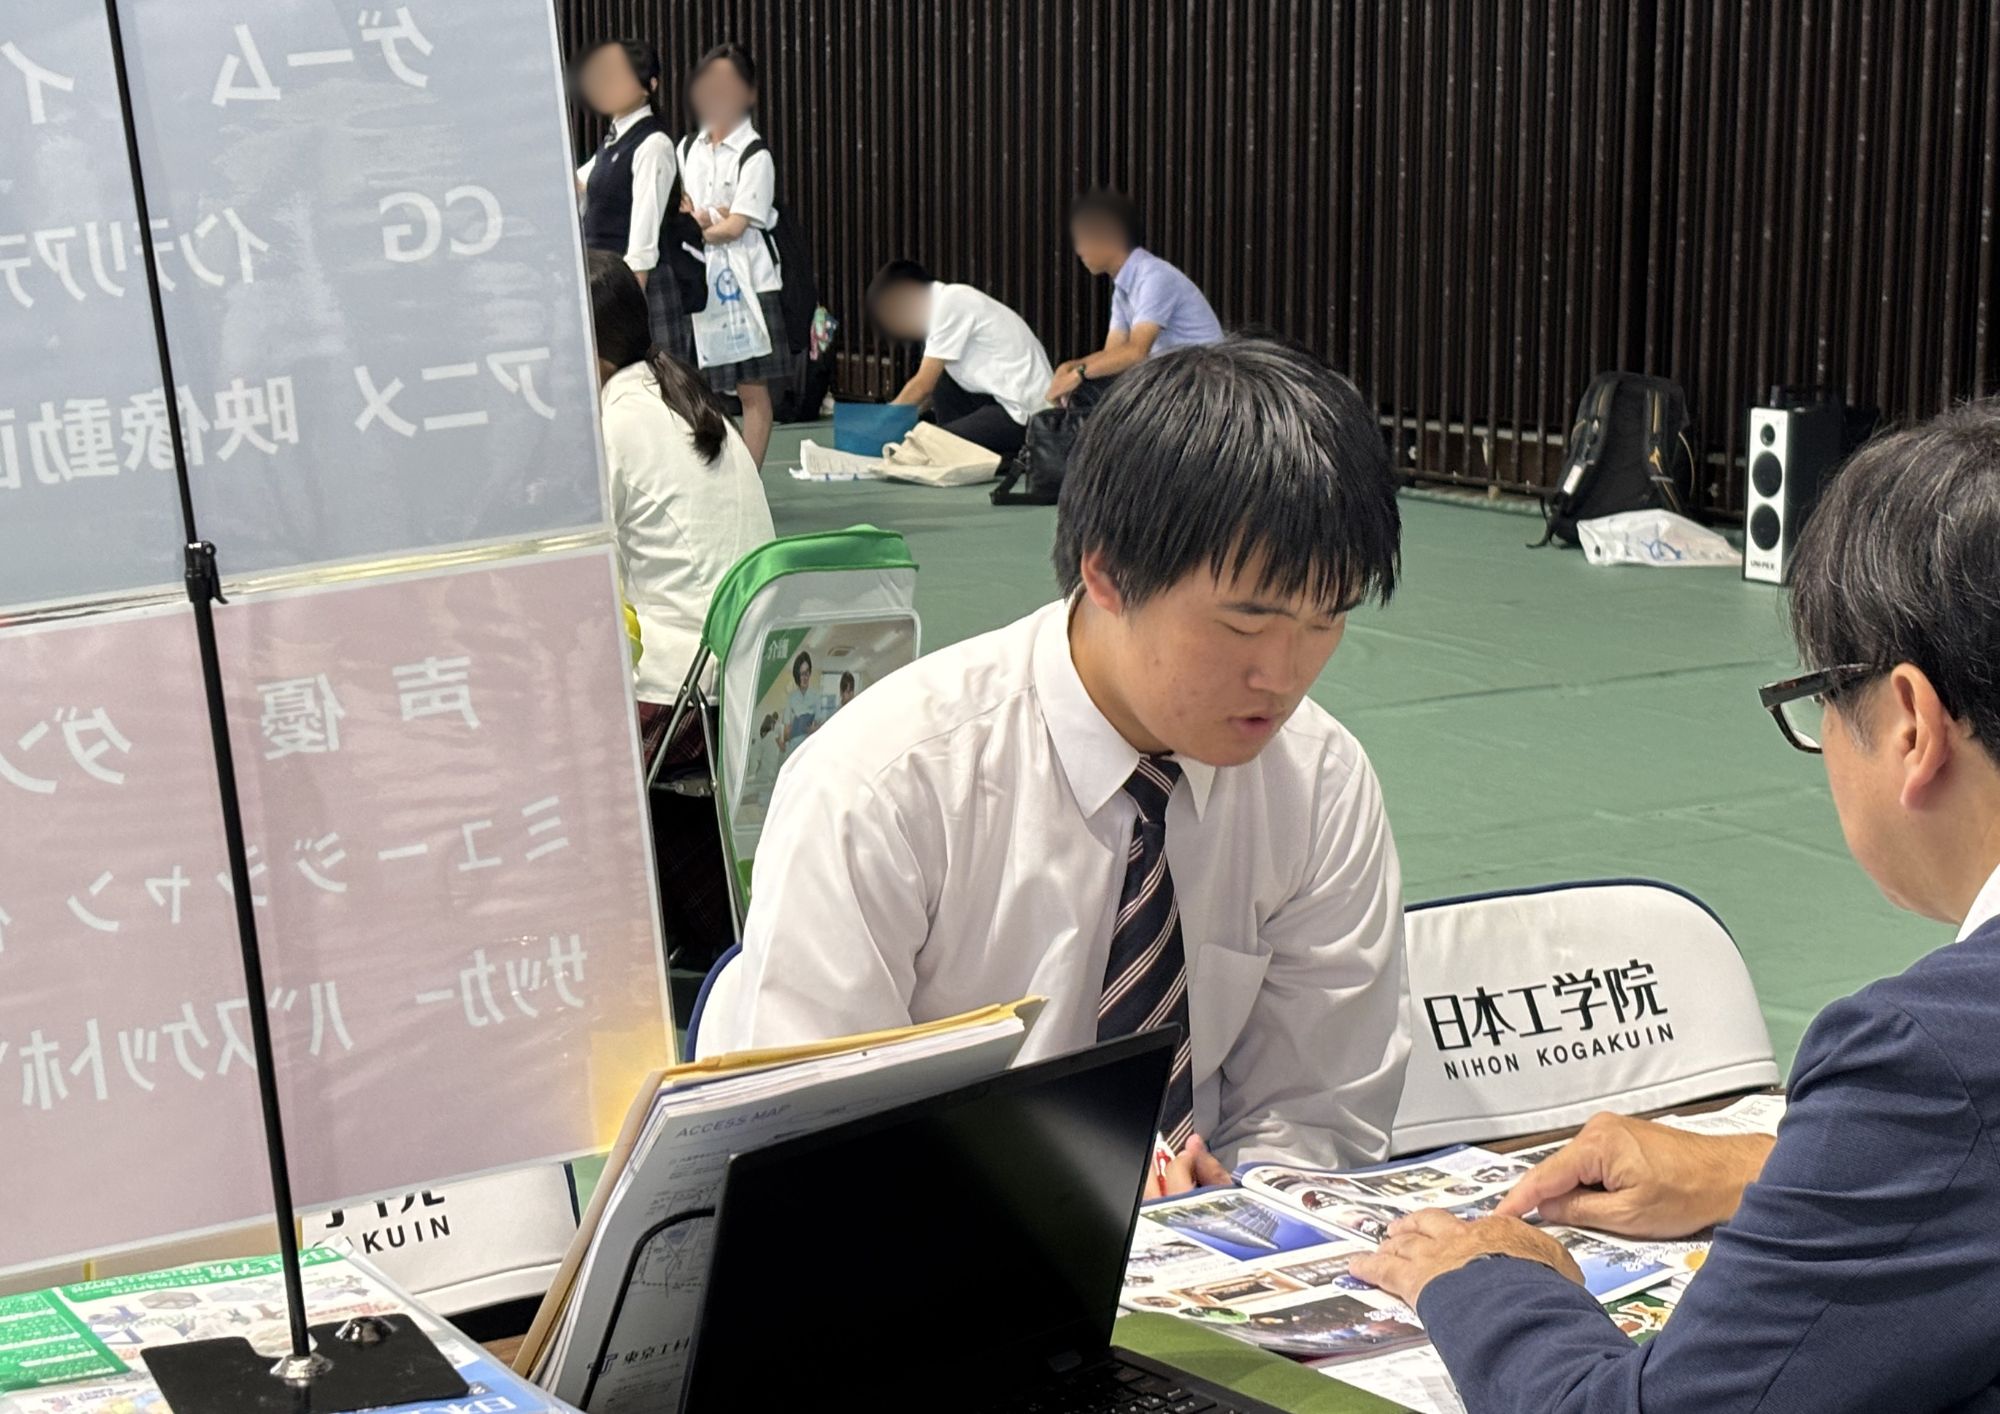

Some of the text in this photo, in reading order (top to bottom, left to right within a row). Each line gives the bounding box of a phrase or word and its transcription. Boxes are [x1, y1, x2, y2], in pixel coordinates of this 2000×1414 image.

[1423, 958, 1668, 1051] 日本工学院
[1444, 1022, 1675, 1080] NIHON KOGAKUIN
[675, 1104, 791, 1138] ACCESS MAP
